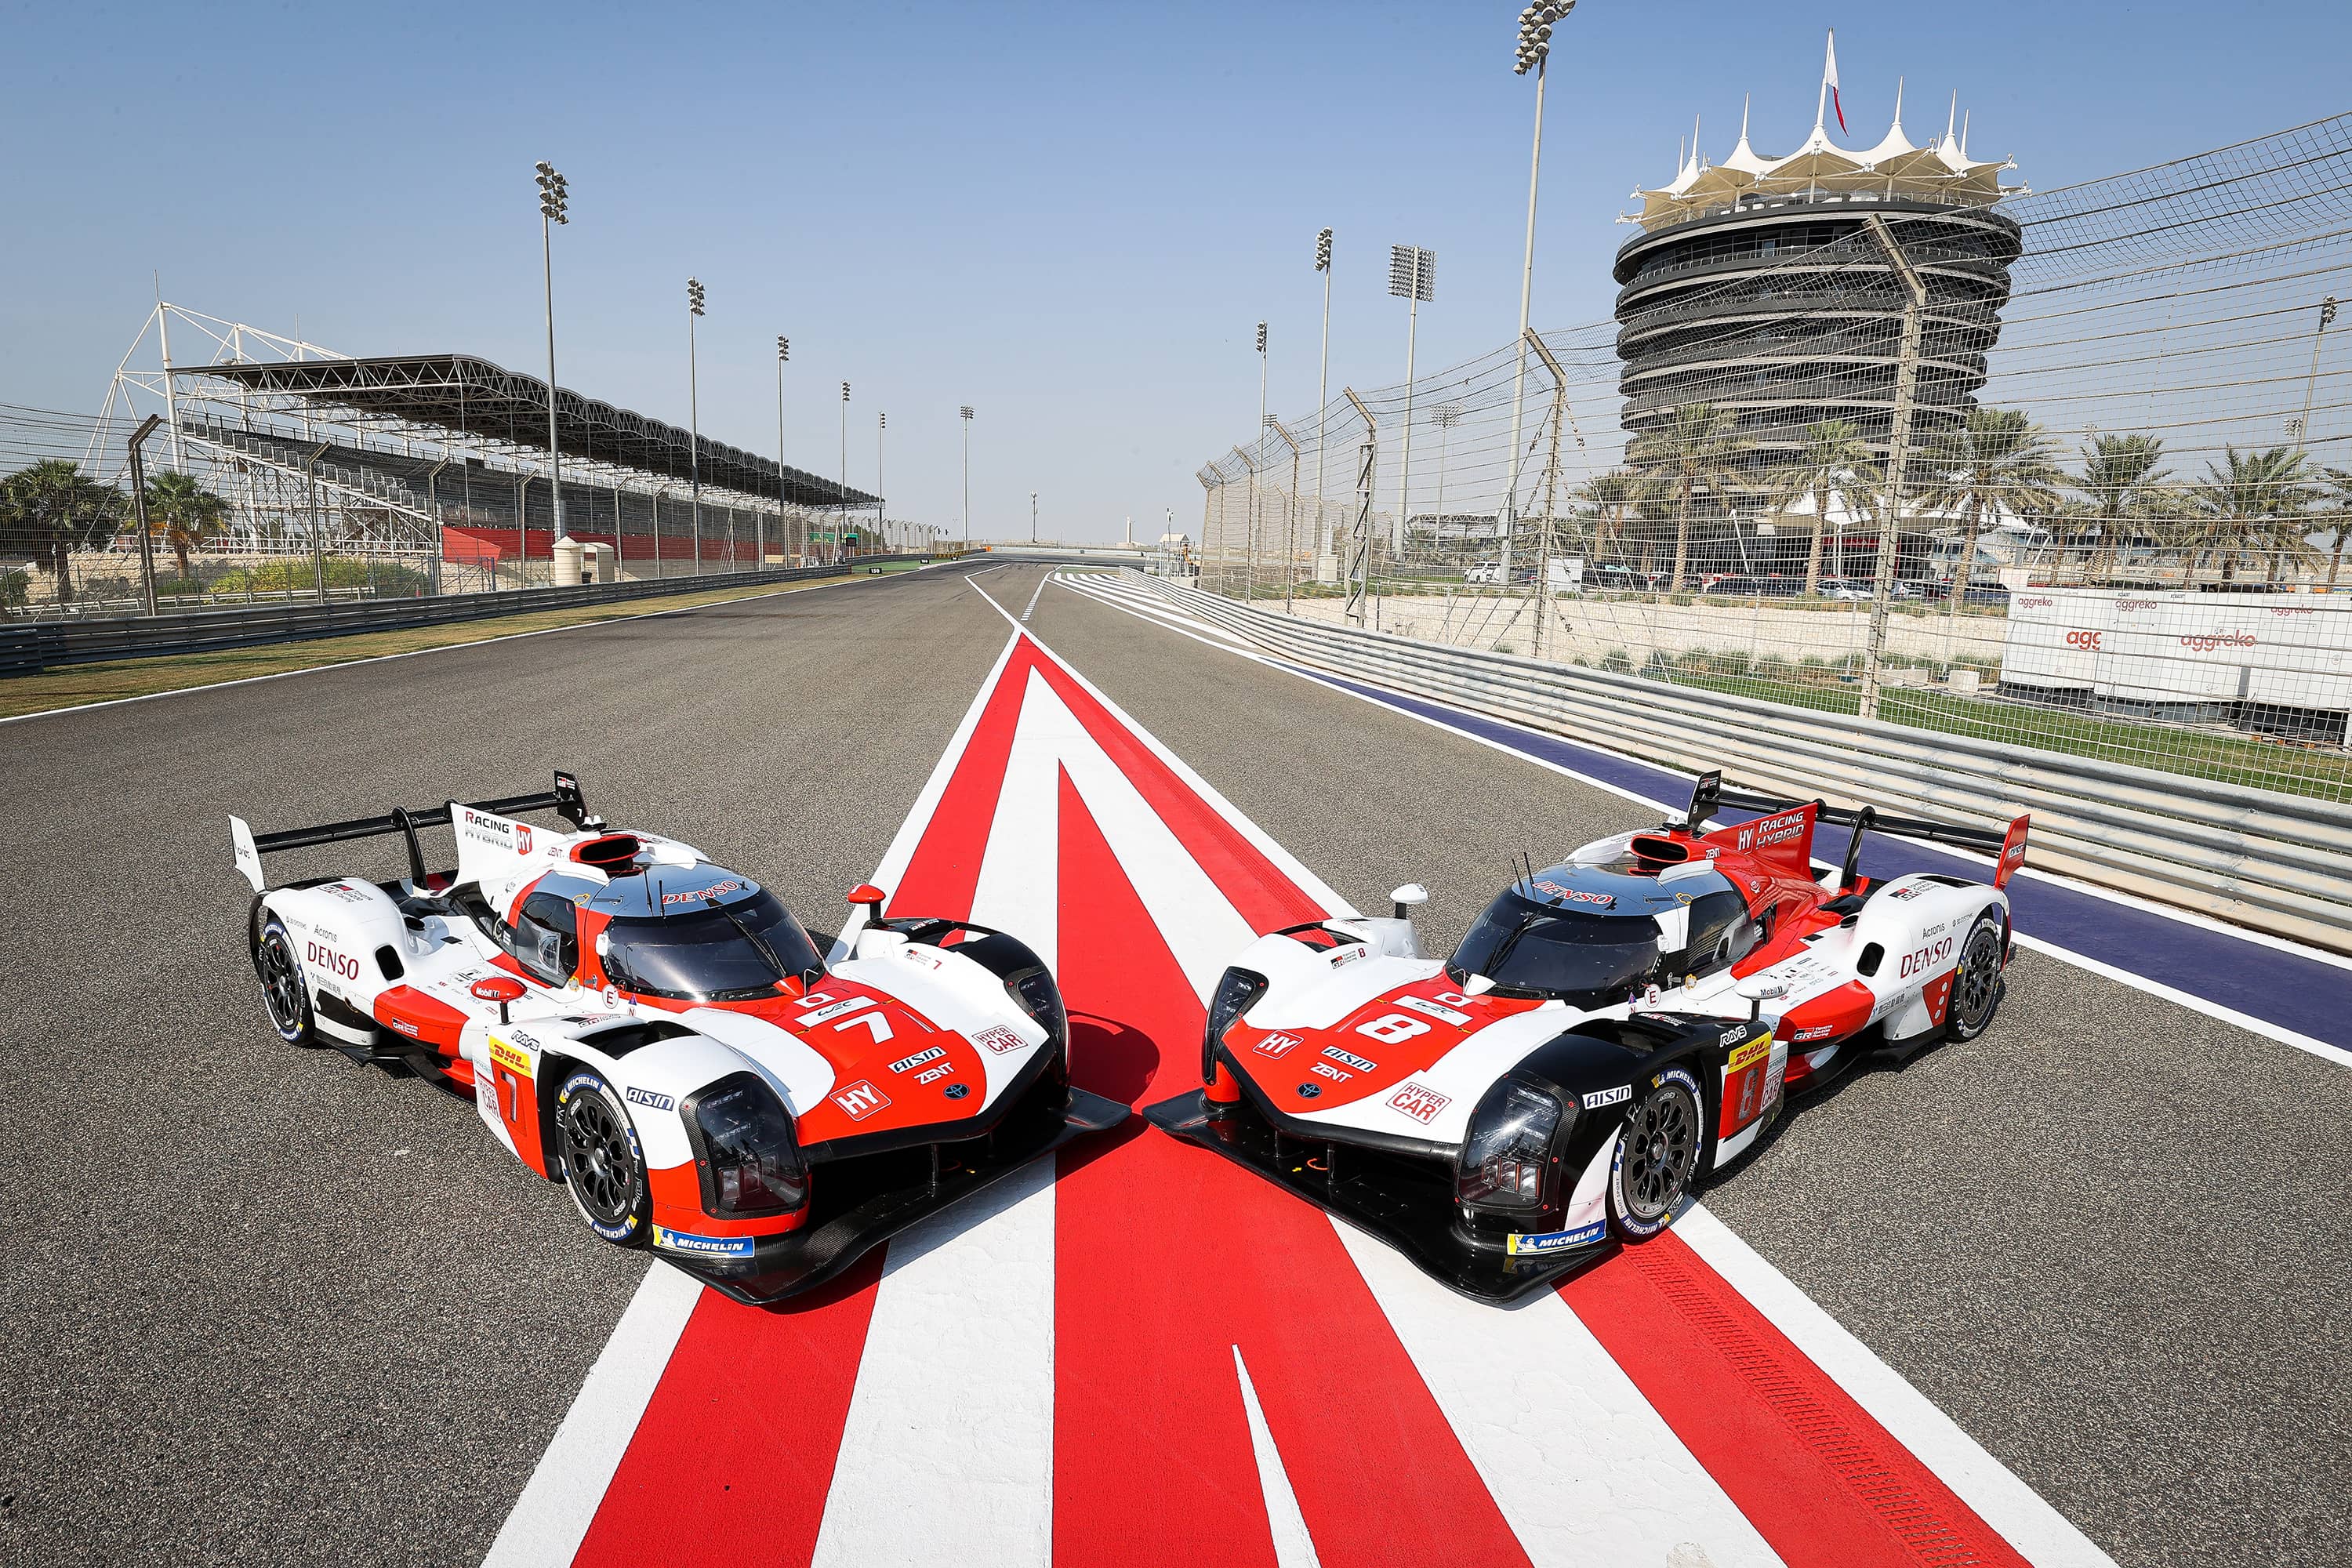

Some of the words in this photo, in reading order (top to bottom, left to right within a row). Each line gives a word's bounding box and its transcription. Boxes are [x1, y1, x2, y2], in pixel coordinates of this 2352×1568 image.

[2018, 596, 2053, 608] aggreko
[2116, 600, 2157, 612] aggreko
[2180, 630, 2256, 652] aggreko
[577, 808, 583, 817] 7
[1693, 804, 1698, 815] 8
[466, 811, 510, 834] RACING
[1759, 811, 1804, 834] RACING
[464, 826, 514, 850] HYBRID
[517, 828, 532, 852] HY
[1738, 828, 1754, 851] HY
[1755, 824, 1805, 850] HYBRID
[547, 847, 563, 858] ZENT
[1705, 847, 1721, 859] ZENT
[662, 880, 739, 905] DENSO
[1532, 880, 1613, 905] DENSO
[314, 924, 338, 942] Acronis
[1922, 923, 1945, 939] Acronis
[307, 941, 359, 980] DENSO
[1358, 947, 1367, 958] 8
[1900, 936, 1952, 979] DENSO
[934, 960, 942, 970] 7
[607, 991, 614, 1004] E
[1650, 990, 1657, 1004] E
[1760, 986, 1777, 996] Mobil
[818, 1000, 852, 1016] WEC
[833, 1011, 895, 1044] 7
[976, 1027, 1010, 1044] HYPER
[1355, 1013, 1432, 1044] 8
[1719, 1025, 1748, 1047] RAYS
[511, 1029, 540, 1051] RAYS
[986, 1033, 1024, 1053] CAR
[1258, 1033, 1298, 1054] HY
[494, 1044, 524, 1069] DHL
[894, 1047, 943, 1073] AISIN
[1324, 1047, 1374, 1071] AISIN
[1734, 1041, 1766, 1066] DHL
[568, 1076, 599, 1091] MICHELIN
[913, 1062, 956, 1085] ZENT
[1309, 1062, 1353, 1083] ZENT
[1666, 1070, 1696, 1091] MICHELIN
[500, 1069, 517, 1123] 7
[627, 1089, 673, 1111] AISIN
[837, 1084, 880, 1116] HY
[1403, 1084, 1446, 1108] HYPER
[1586, 1087, 1631, 1108] AISIN
[1738, 1067, 1759, 1120] 8
[1392, 1093, 1436, 1120] CAR
[594, 1223, 627, 1239] MICHELIN
[1538, 1227, 1599, 1247] MICHELIN
[1624, 1218, 1657, 1235] MICHELIN
[677, 1238, 744, 1251] MICHELIN
